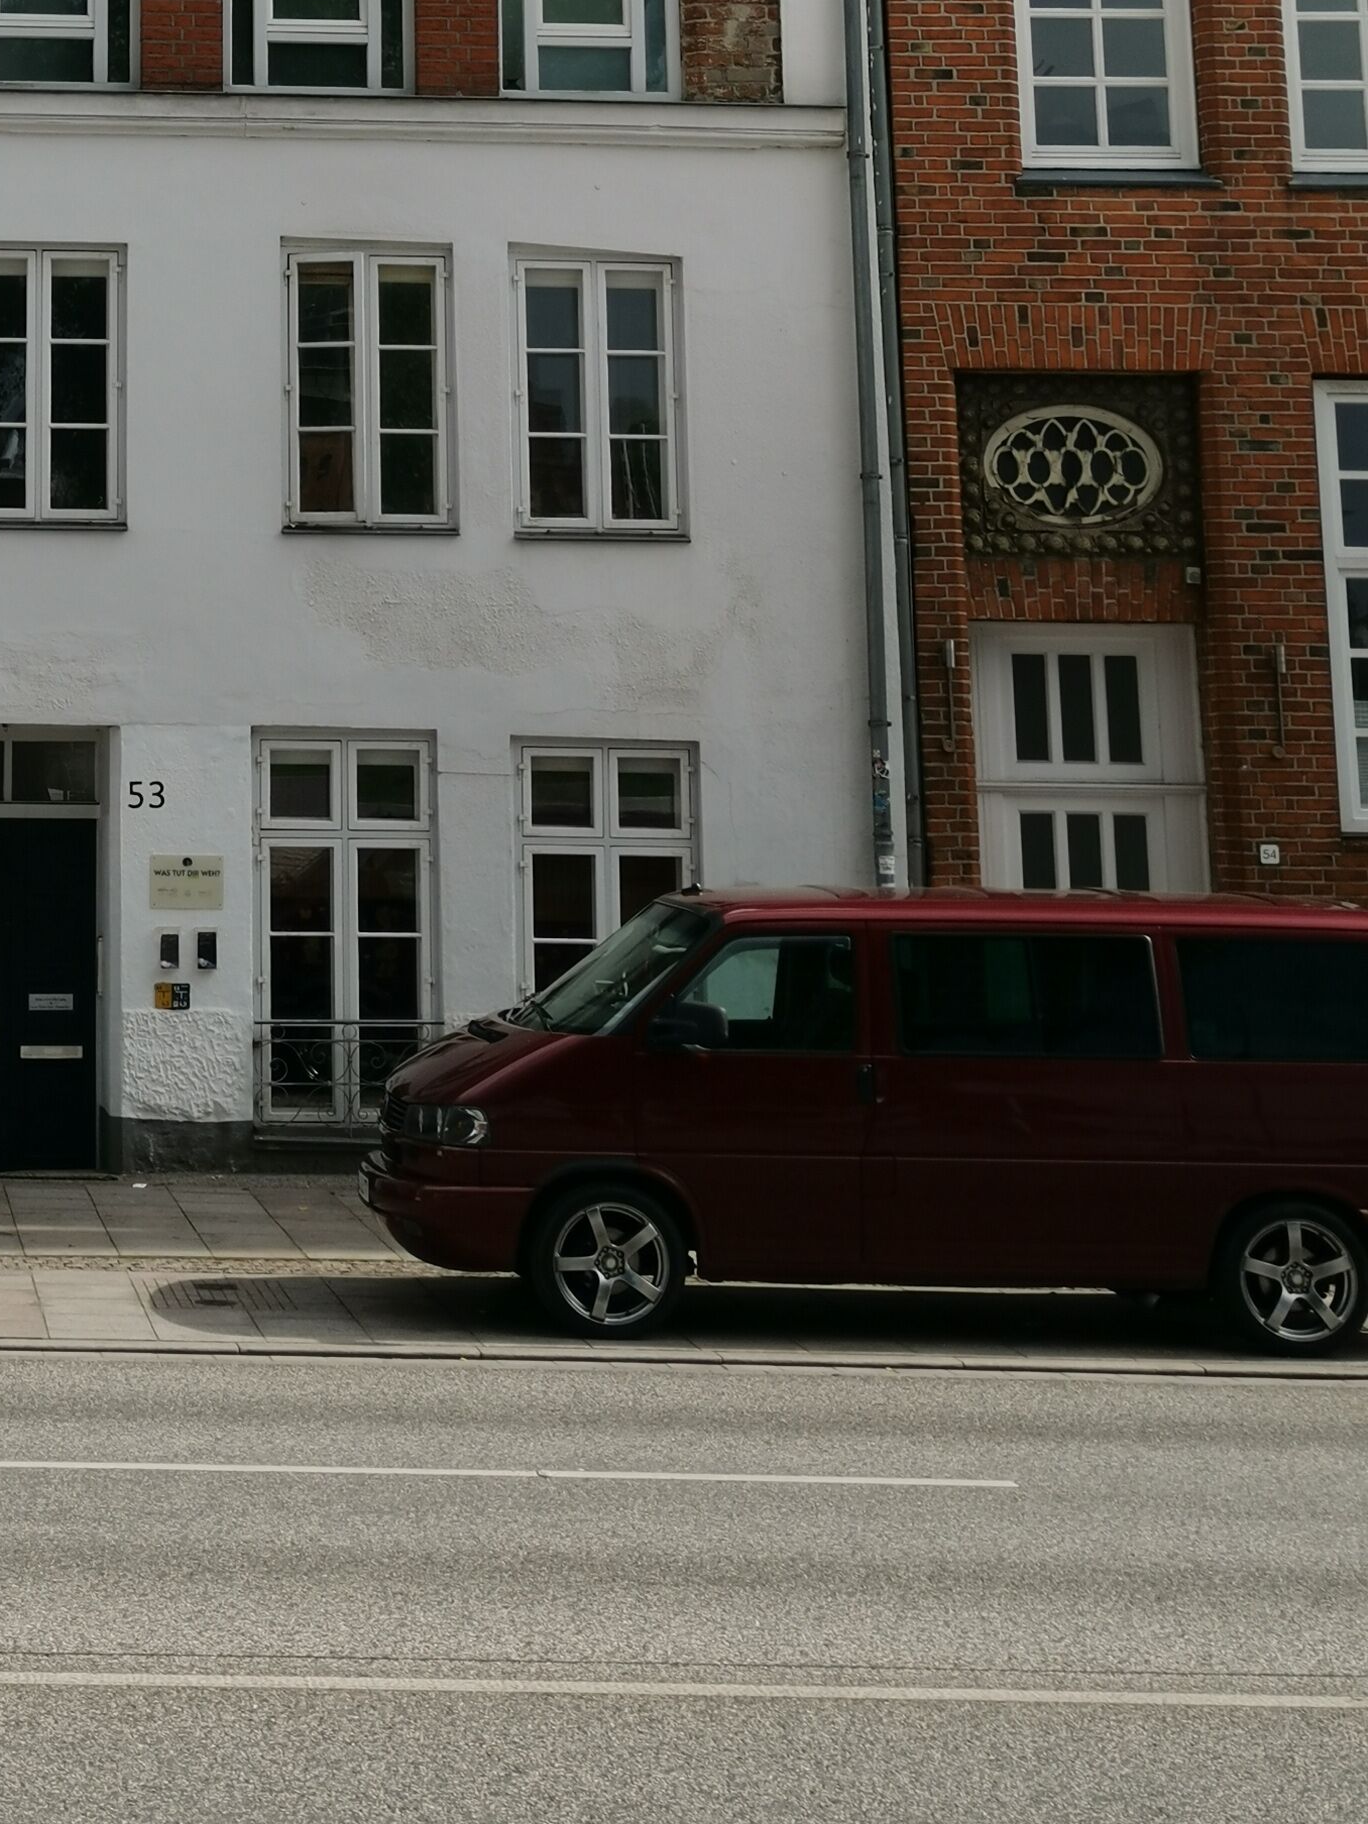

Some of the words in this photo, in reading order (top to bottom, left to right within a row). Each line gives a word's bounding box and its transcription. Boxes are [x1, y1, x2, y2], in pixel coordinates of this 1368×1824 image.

[128, 781, 165, 809] 53
[1262, 848, 1277, 860] 54
[153, 869, 170, 877] WAS
[187, 870, 199, 878] DIR
[201, 870, 221, 878] WEH?
